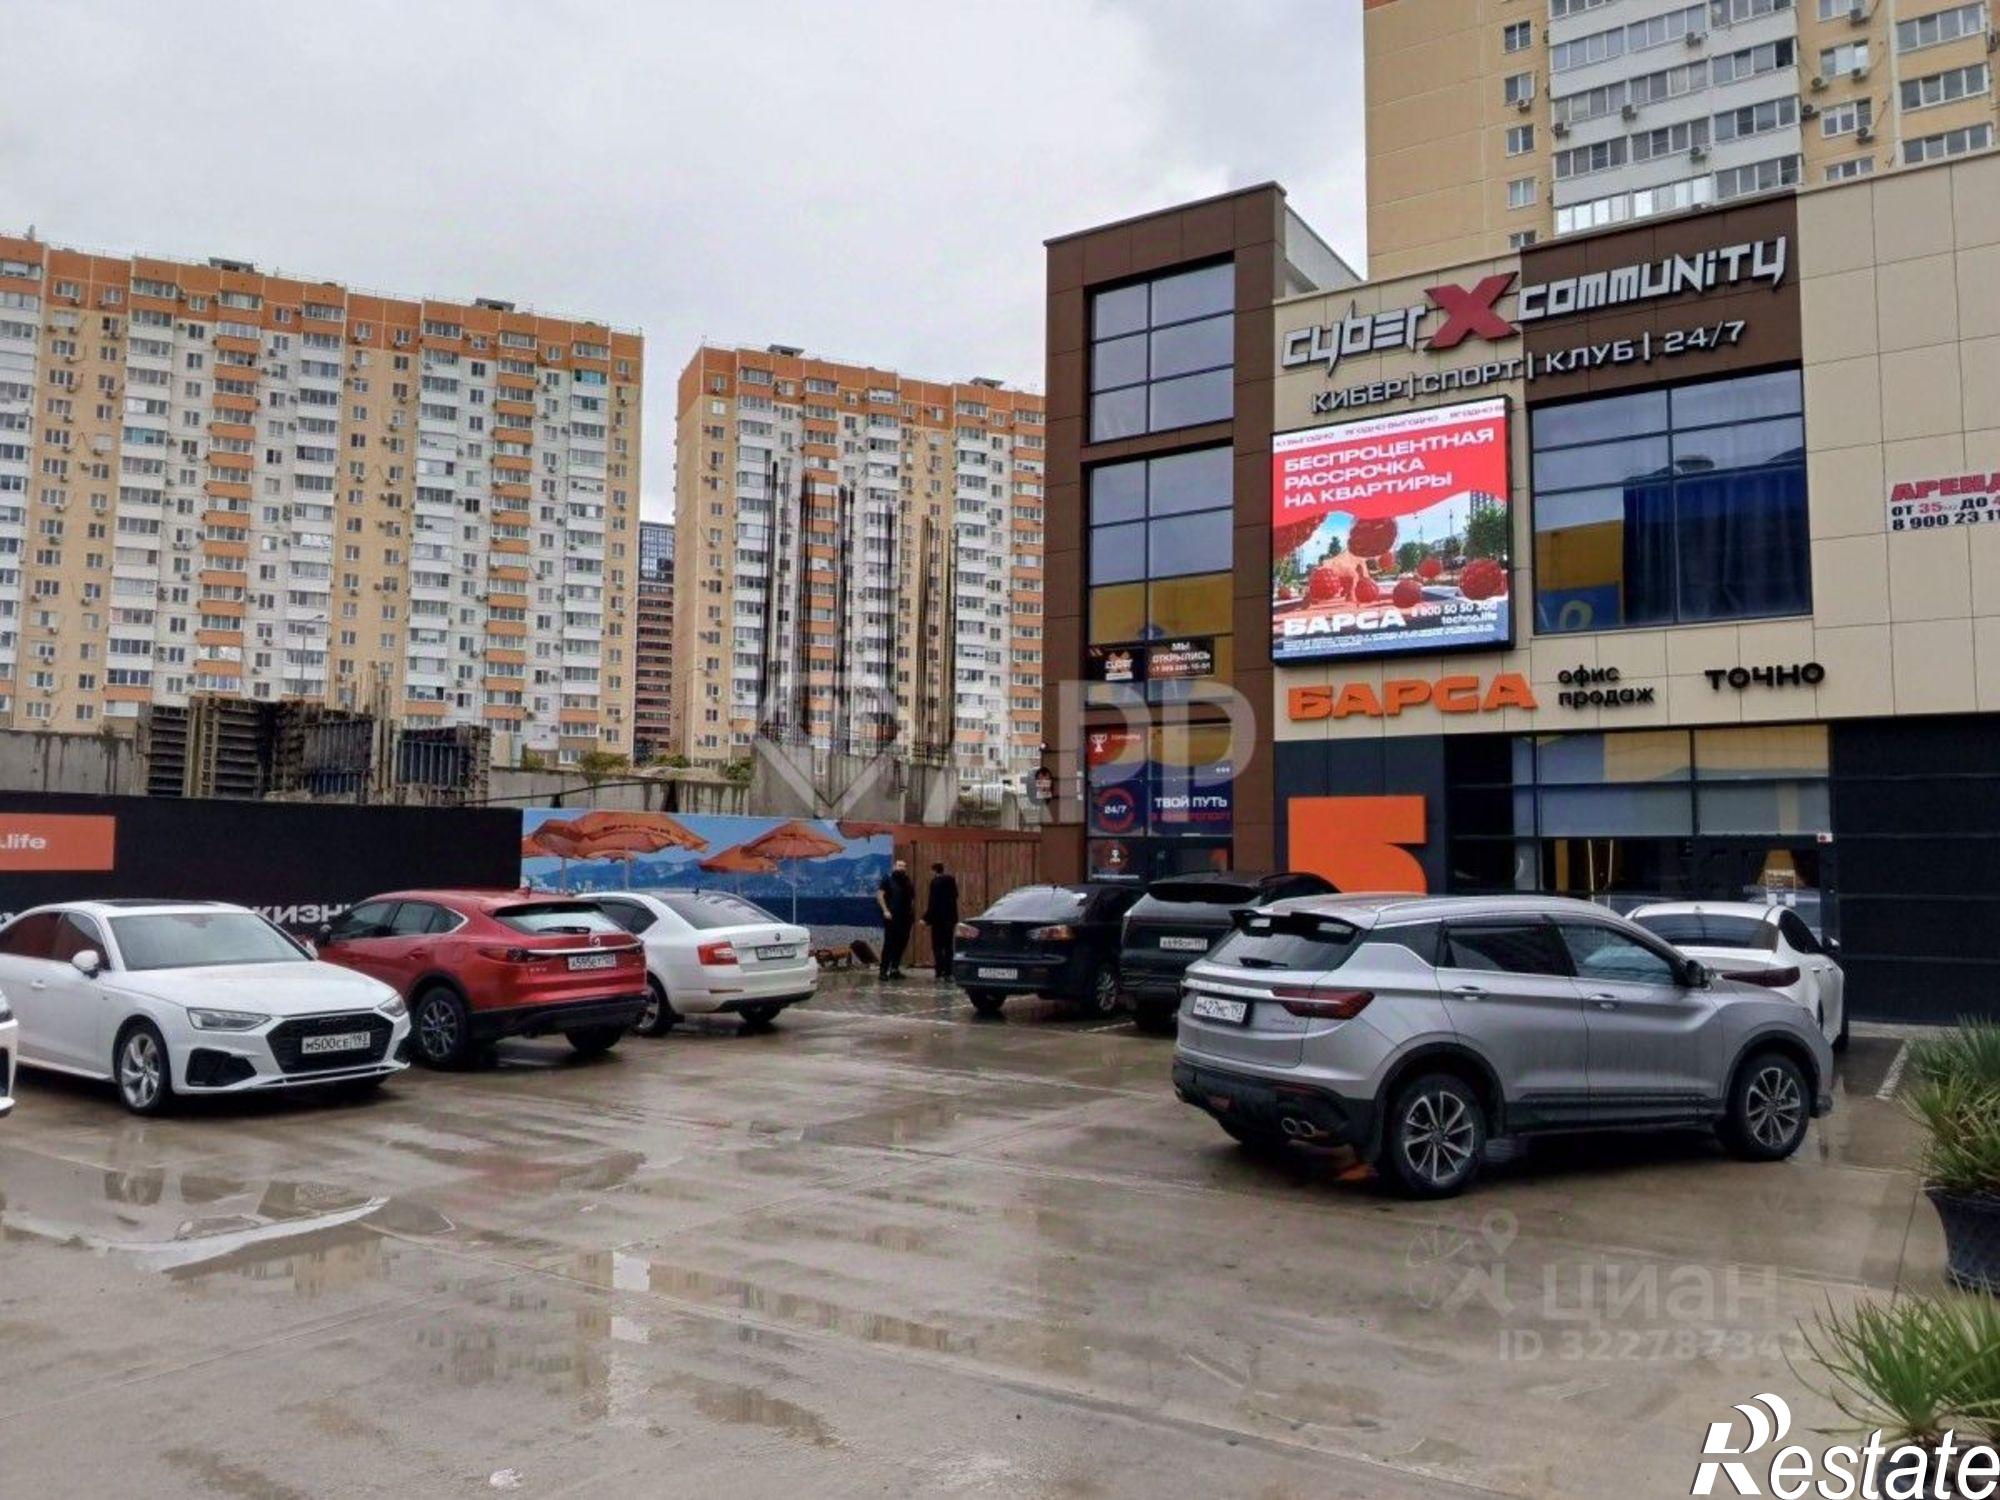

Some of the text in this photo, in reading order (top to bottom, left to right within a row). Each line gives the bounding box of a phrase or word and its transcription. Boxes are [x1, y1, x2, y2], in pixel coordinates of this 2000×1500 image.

[1545, 340, 1634, 373] КЛУБ
[1664, 320, 1746, 353] 24/7
[1284, 427, 1495, 473] БЕСПРОЦЕНТНАЯ
[1284, 458, 1426, 490] РАССРОЧКА
[1284, 472, 1453, 509] НА КВАРТИРЫ
[1893, 518, 1904, 531] 8
[1909, 515, 1949, 529] 900
[1954, 510, 1979, 525] 23
[1284, 609, 1406, 636] БАРСА
[1558, 664, 1620, 688] офис
[1288, 672, 1539, 721] БАРСА
[1558, 687, 1655, 709] продаж
[1154, 794, 1228, 809] ТВОЙ ПУТЬ
